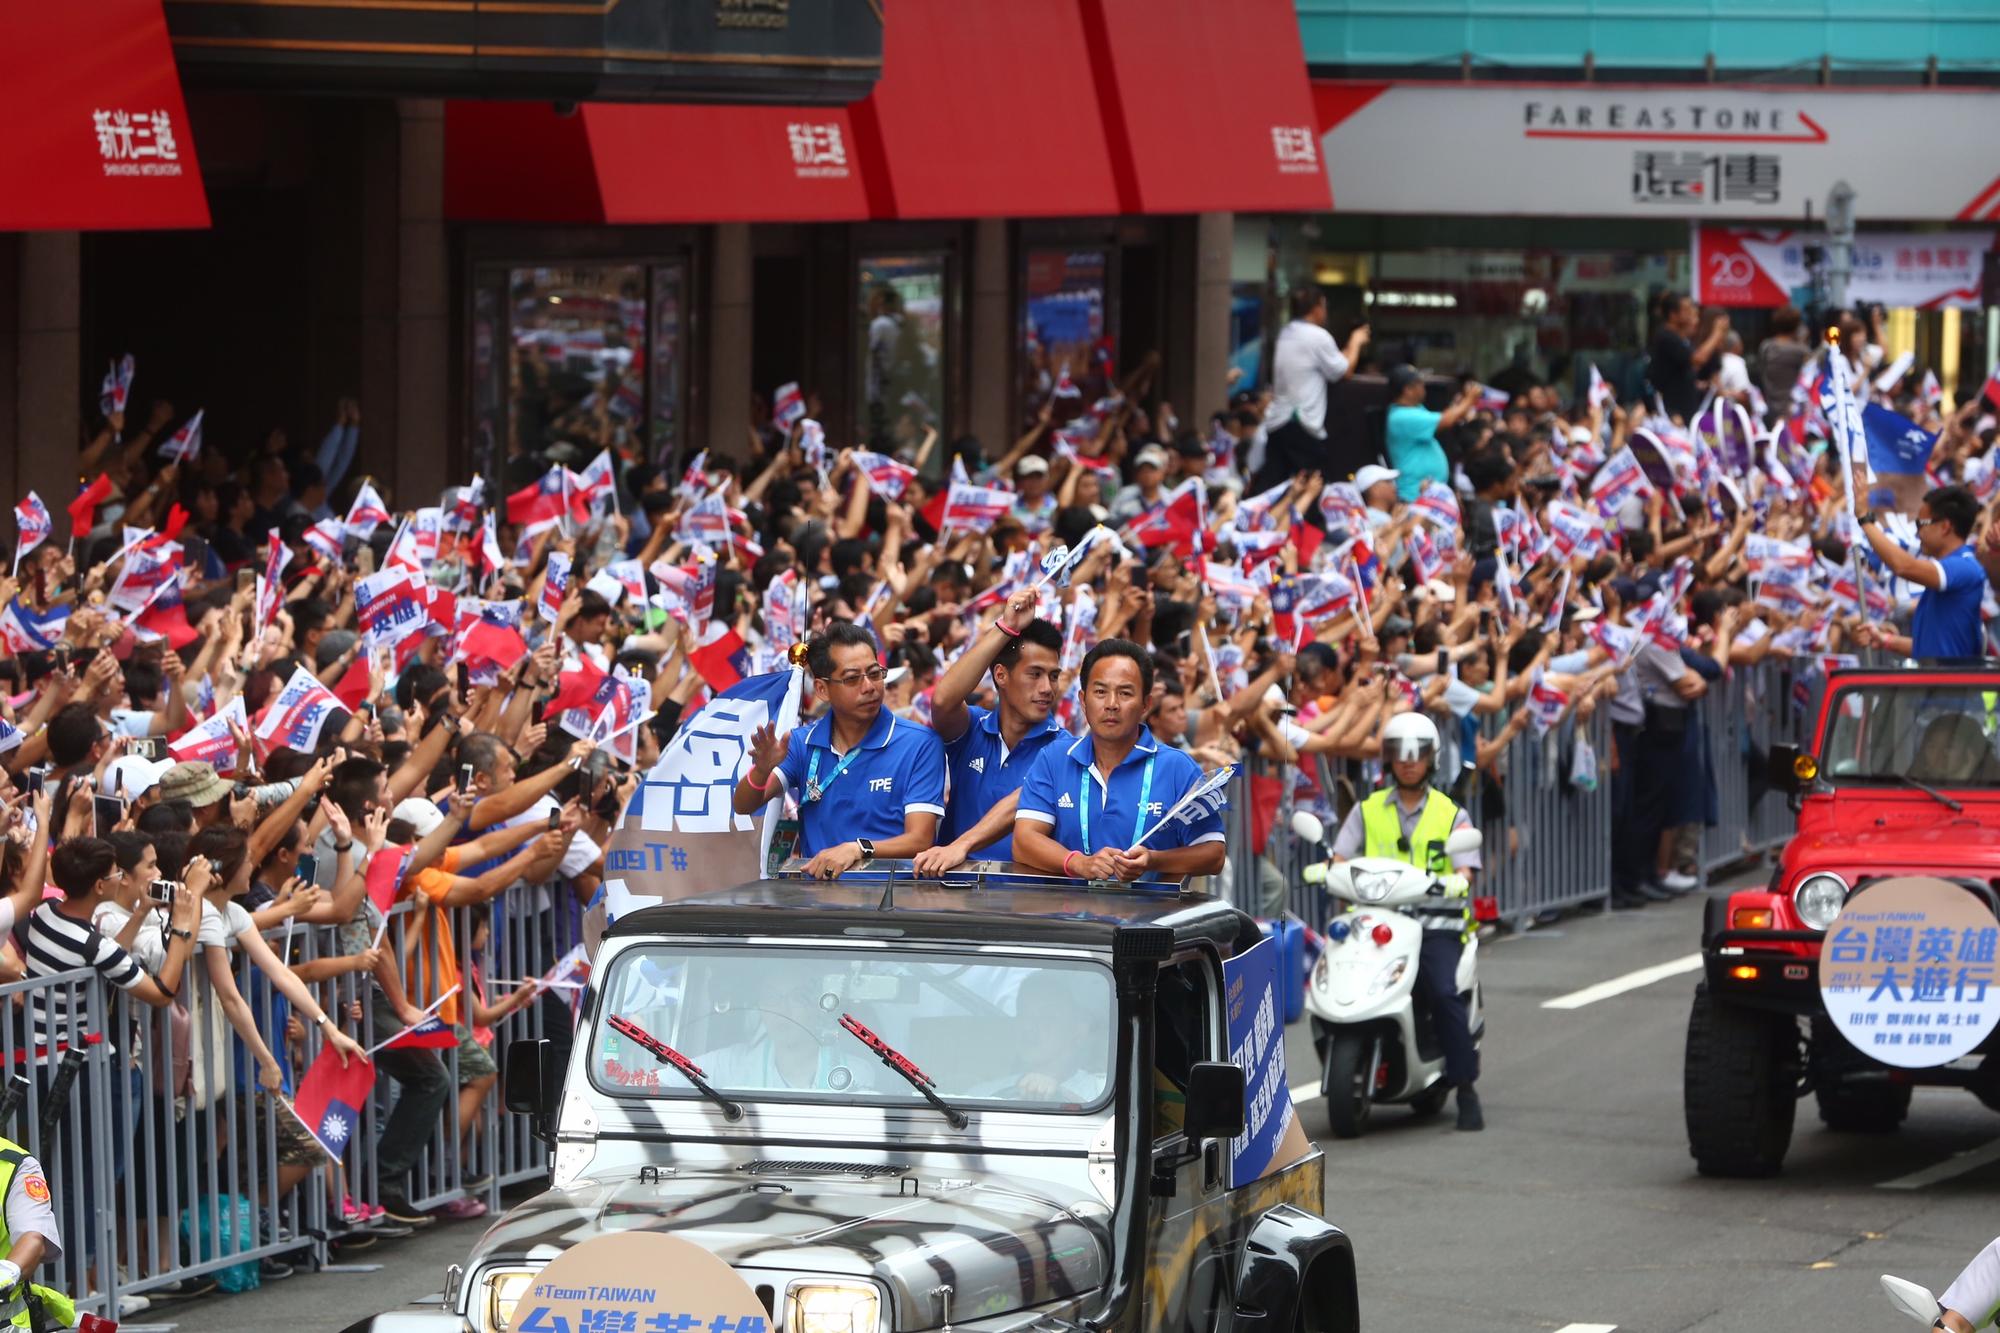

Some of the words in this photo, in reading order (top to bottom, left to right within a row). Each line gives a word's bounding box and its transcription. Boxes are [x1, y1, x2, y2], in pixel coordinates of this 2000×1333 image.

[1525, 103, 1784, 130] FAREASTONE
[93, 109, 178, 160] 新光三越
[869, 777, 893, 793] TPE
[1137, 802, 1163, 815] PE
[1830, 926, 1999, 964] 台灣英雄
[1867, 966, 1994, 1003] 大遊行
[534, 1284, 656, 1304] #TeamTAIWAN
